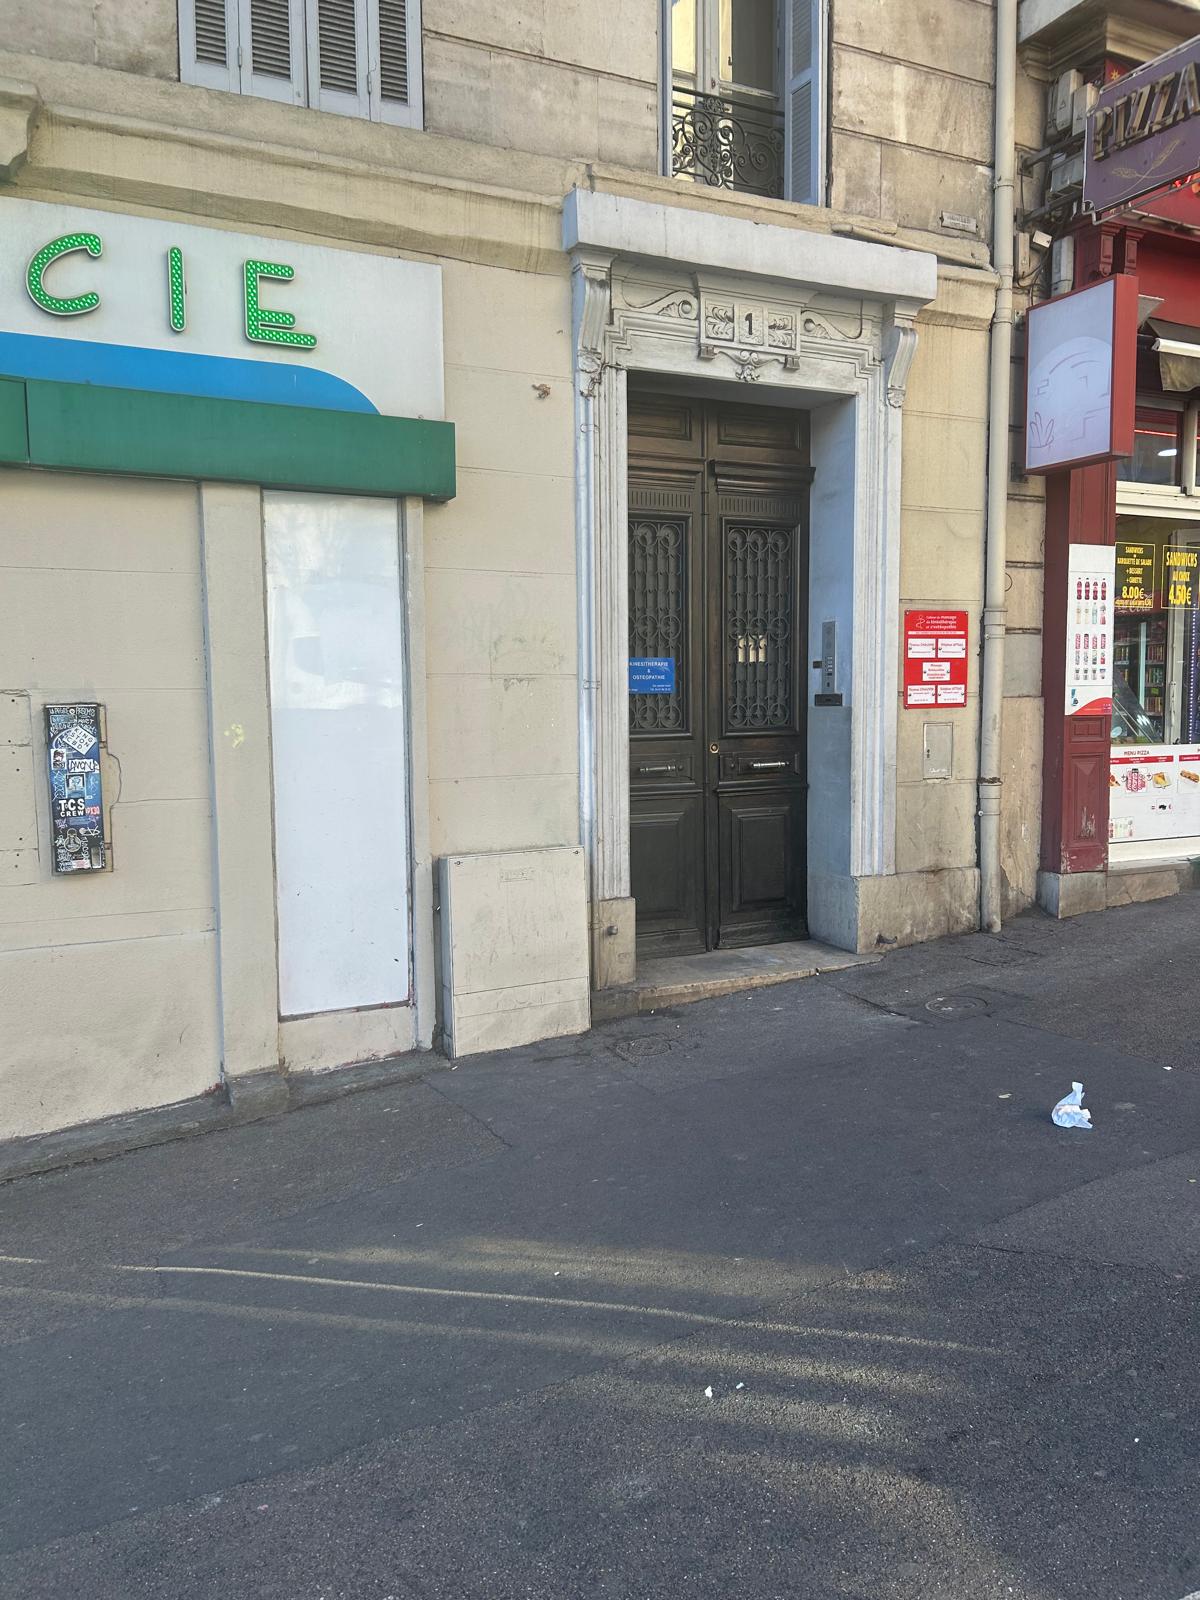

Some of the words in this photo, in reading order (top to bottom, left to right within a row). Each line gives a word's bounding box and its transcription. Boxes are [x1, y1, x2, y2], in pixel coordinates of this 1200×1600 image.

[1093, 61, 1200, 161] PIZZA
[26, 232, 317, 349] CIE
[745, 313, 752, 335] 1
[58, 798, 85, 812] TCS
